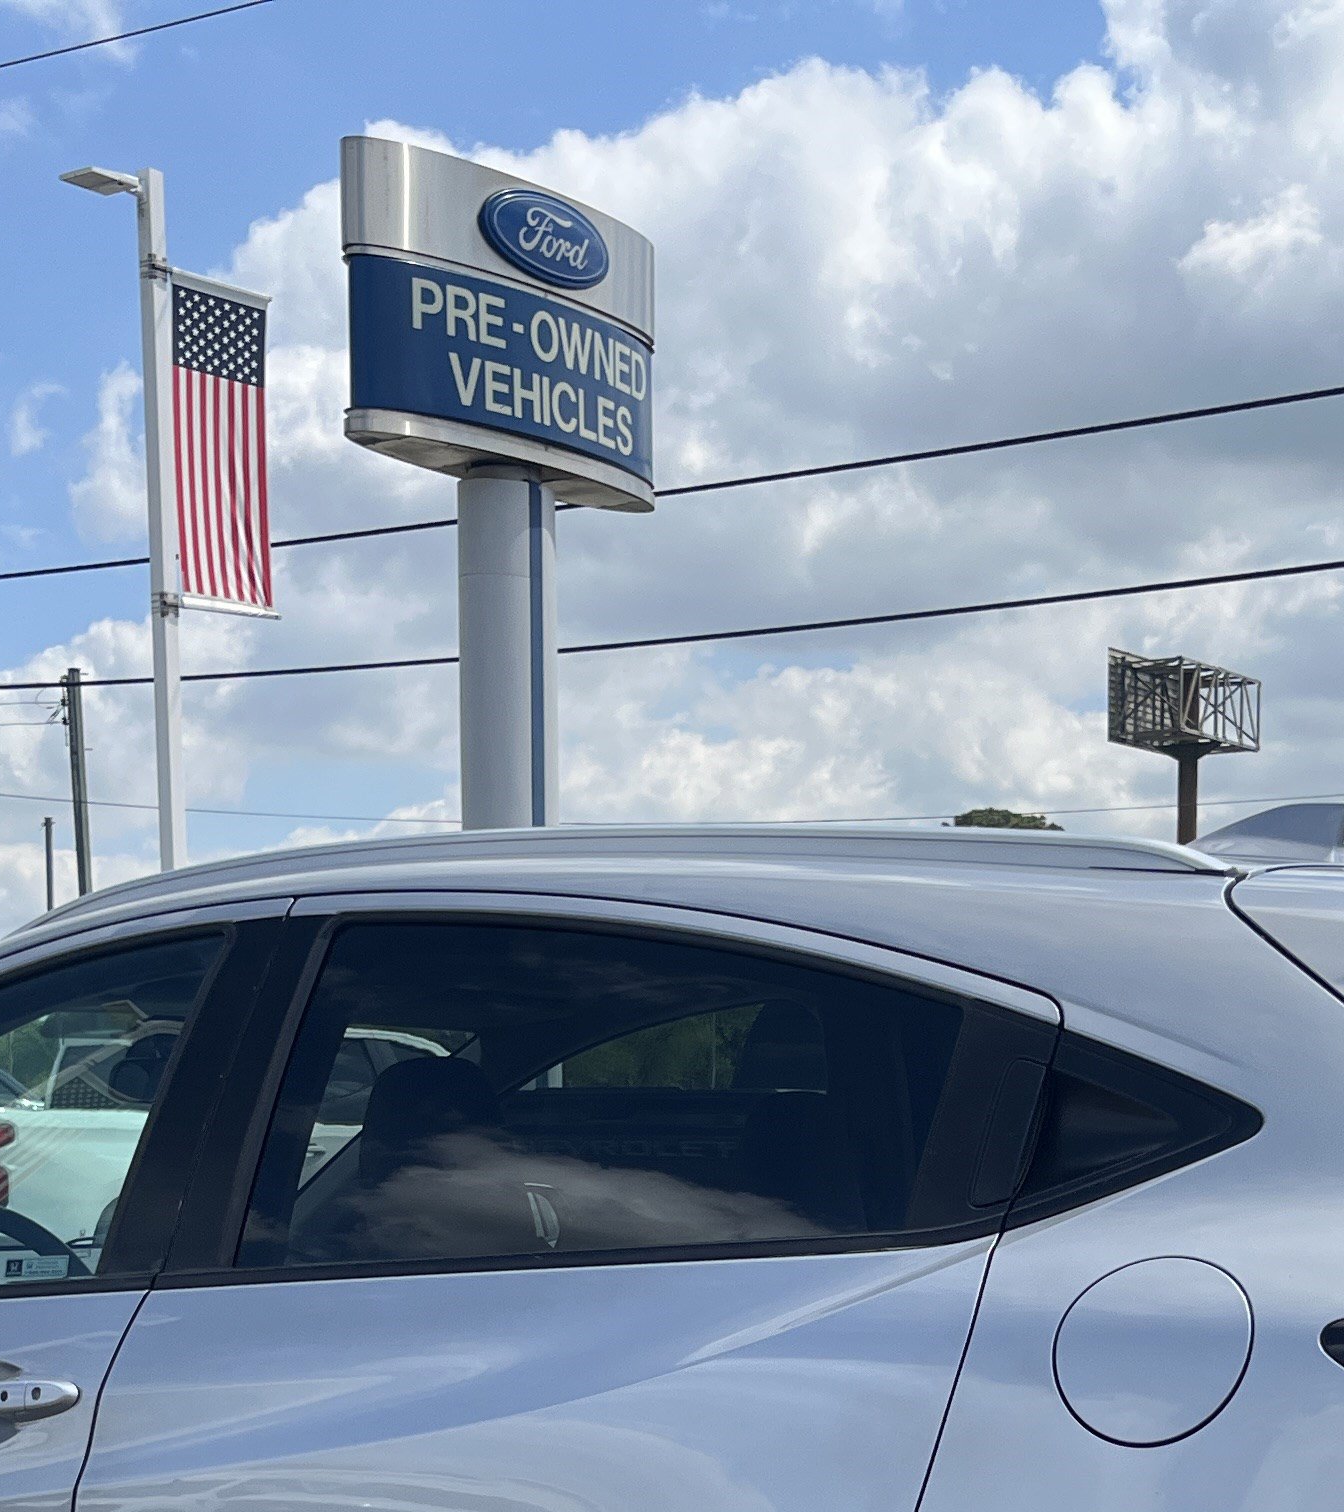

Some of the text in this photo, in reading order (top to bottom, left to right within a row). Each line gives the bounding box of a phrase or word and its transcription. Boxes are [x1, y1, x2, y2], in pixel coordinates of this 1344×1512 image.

[517, 206, 589, 271] Ford
[411, 276, 647, 402] PRE-OWNED
[448, 351, 634, 457] VEHICLES
